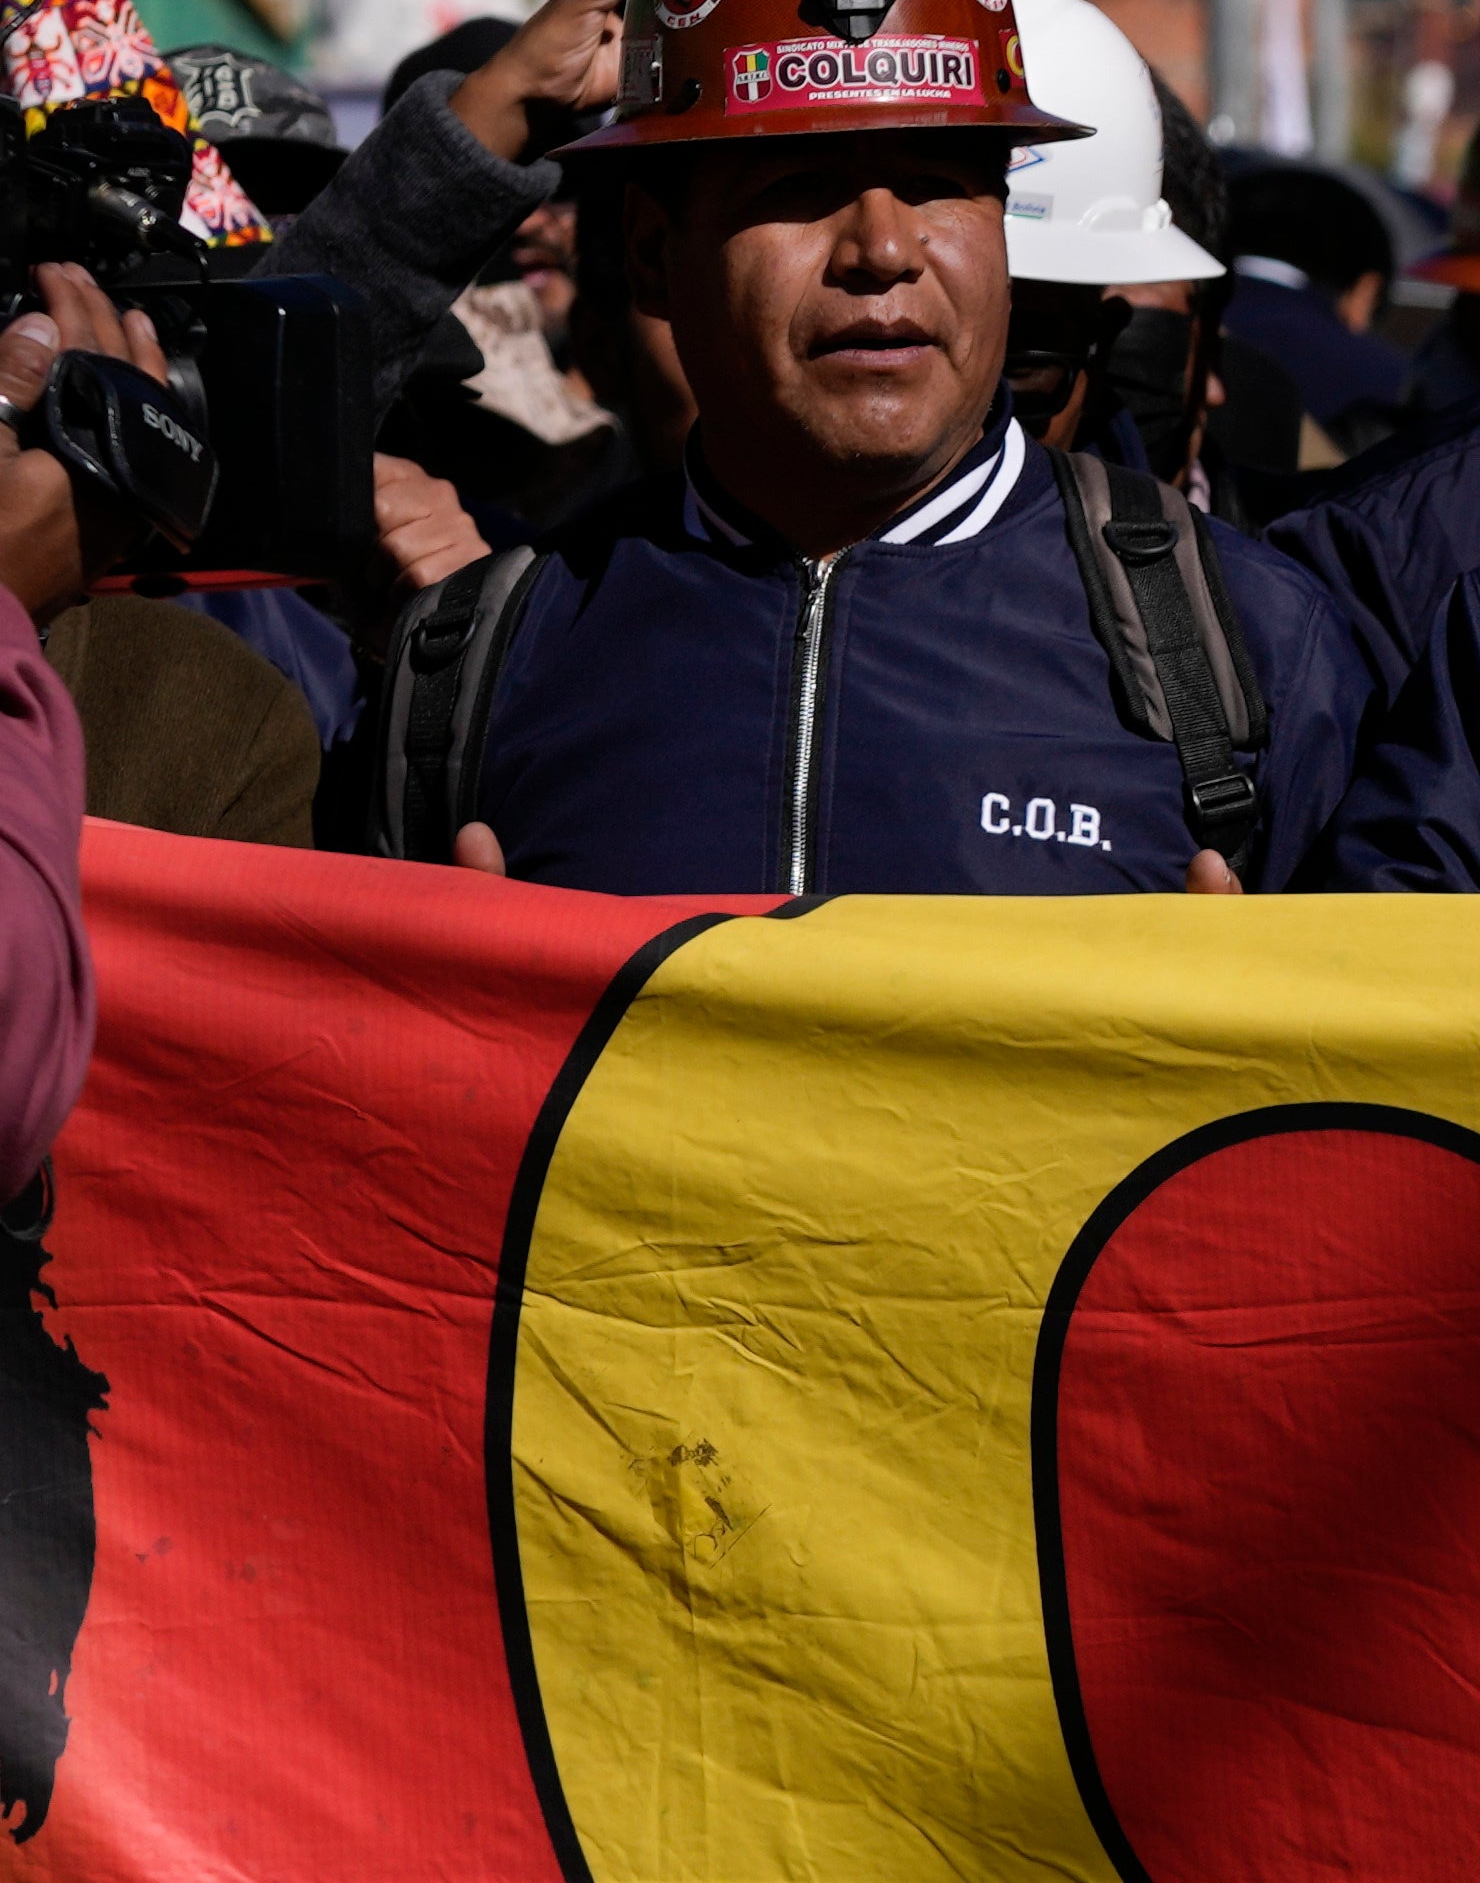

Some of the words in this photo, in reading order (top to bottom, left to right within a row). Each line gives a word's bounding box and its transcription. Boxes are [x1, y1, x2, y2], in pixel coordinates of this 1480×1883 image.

[777, 40, 825, 54] SINDICATO
[776, 49, 974, 90] COLQUIRI
[808, 89, 882, 101] PRESENTES
[902, 89, 916, 99] LA
[917, 89, 952, 99] LUCHA
[141, 402, 204, 463] SONY
[980, 792, 1112, 852] C.O.B.
